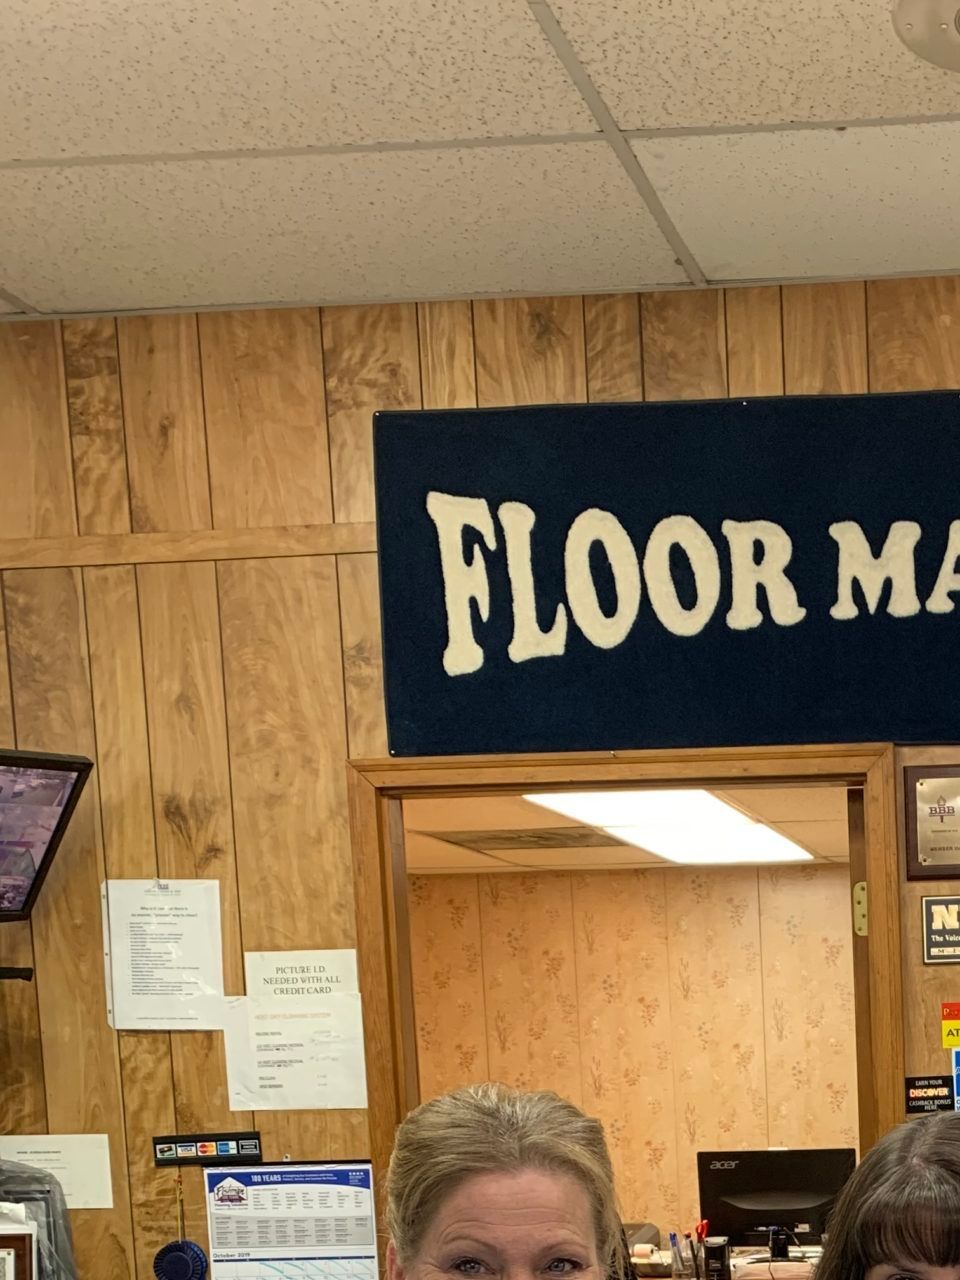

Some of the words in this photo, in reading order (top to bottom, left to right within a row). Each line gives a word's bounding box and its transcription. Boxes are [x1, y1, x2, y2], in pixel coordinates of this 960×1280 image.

[427, 492, 806, 676] FLOOR
[928, 805, 955, 815] BBB
[931, 934, 944, 942] The
[275, 966, 312, 975] PICTURE
[263, 977, 299, 985] NEEDED
[299, 976, 324, 984] WITH
[325, 975, 342, 983] ALL
[273, 987, 305, 995] CREDIT
[306, 986, 332, 994] CARD
[909, 1087, 949, 1098] DISCOVER
[710, 1160, 739, 1169] acer
[262, 1174, 282, 1182] YEARS
